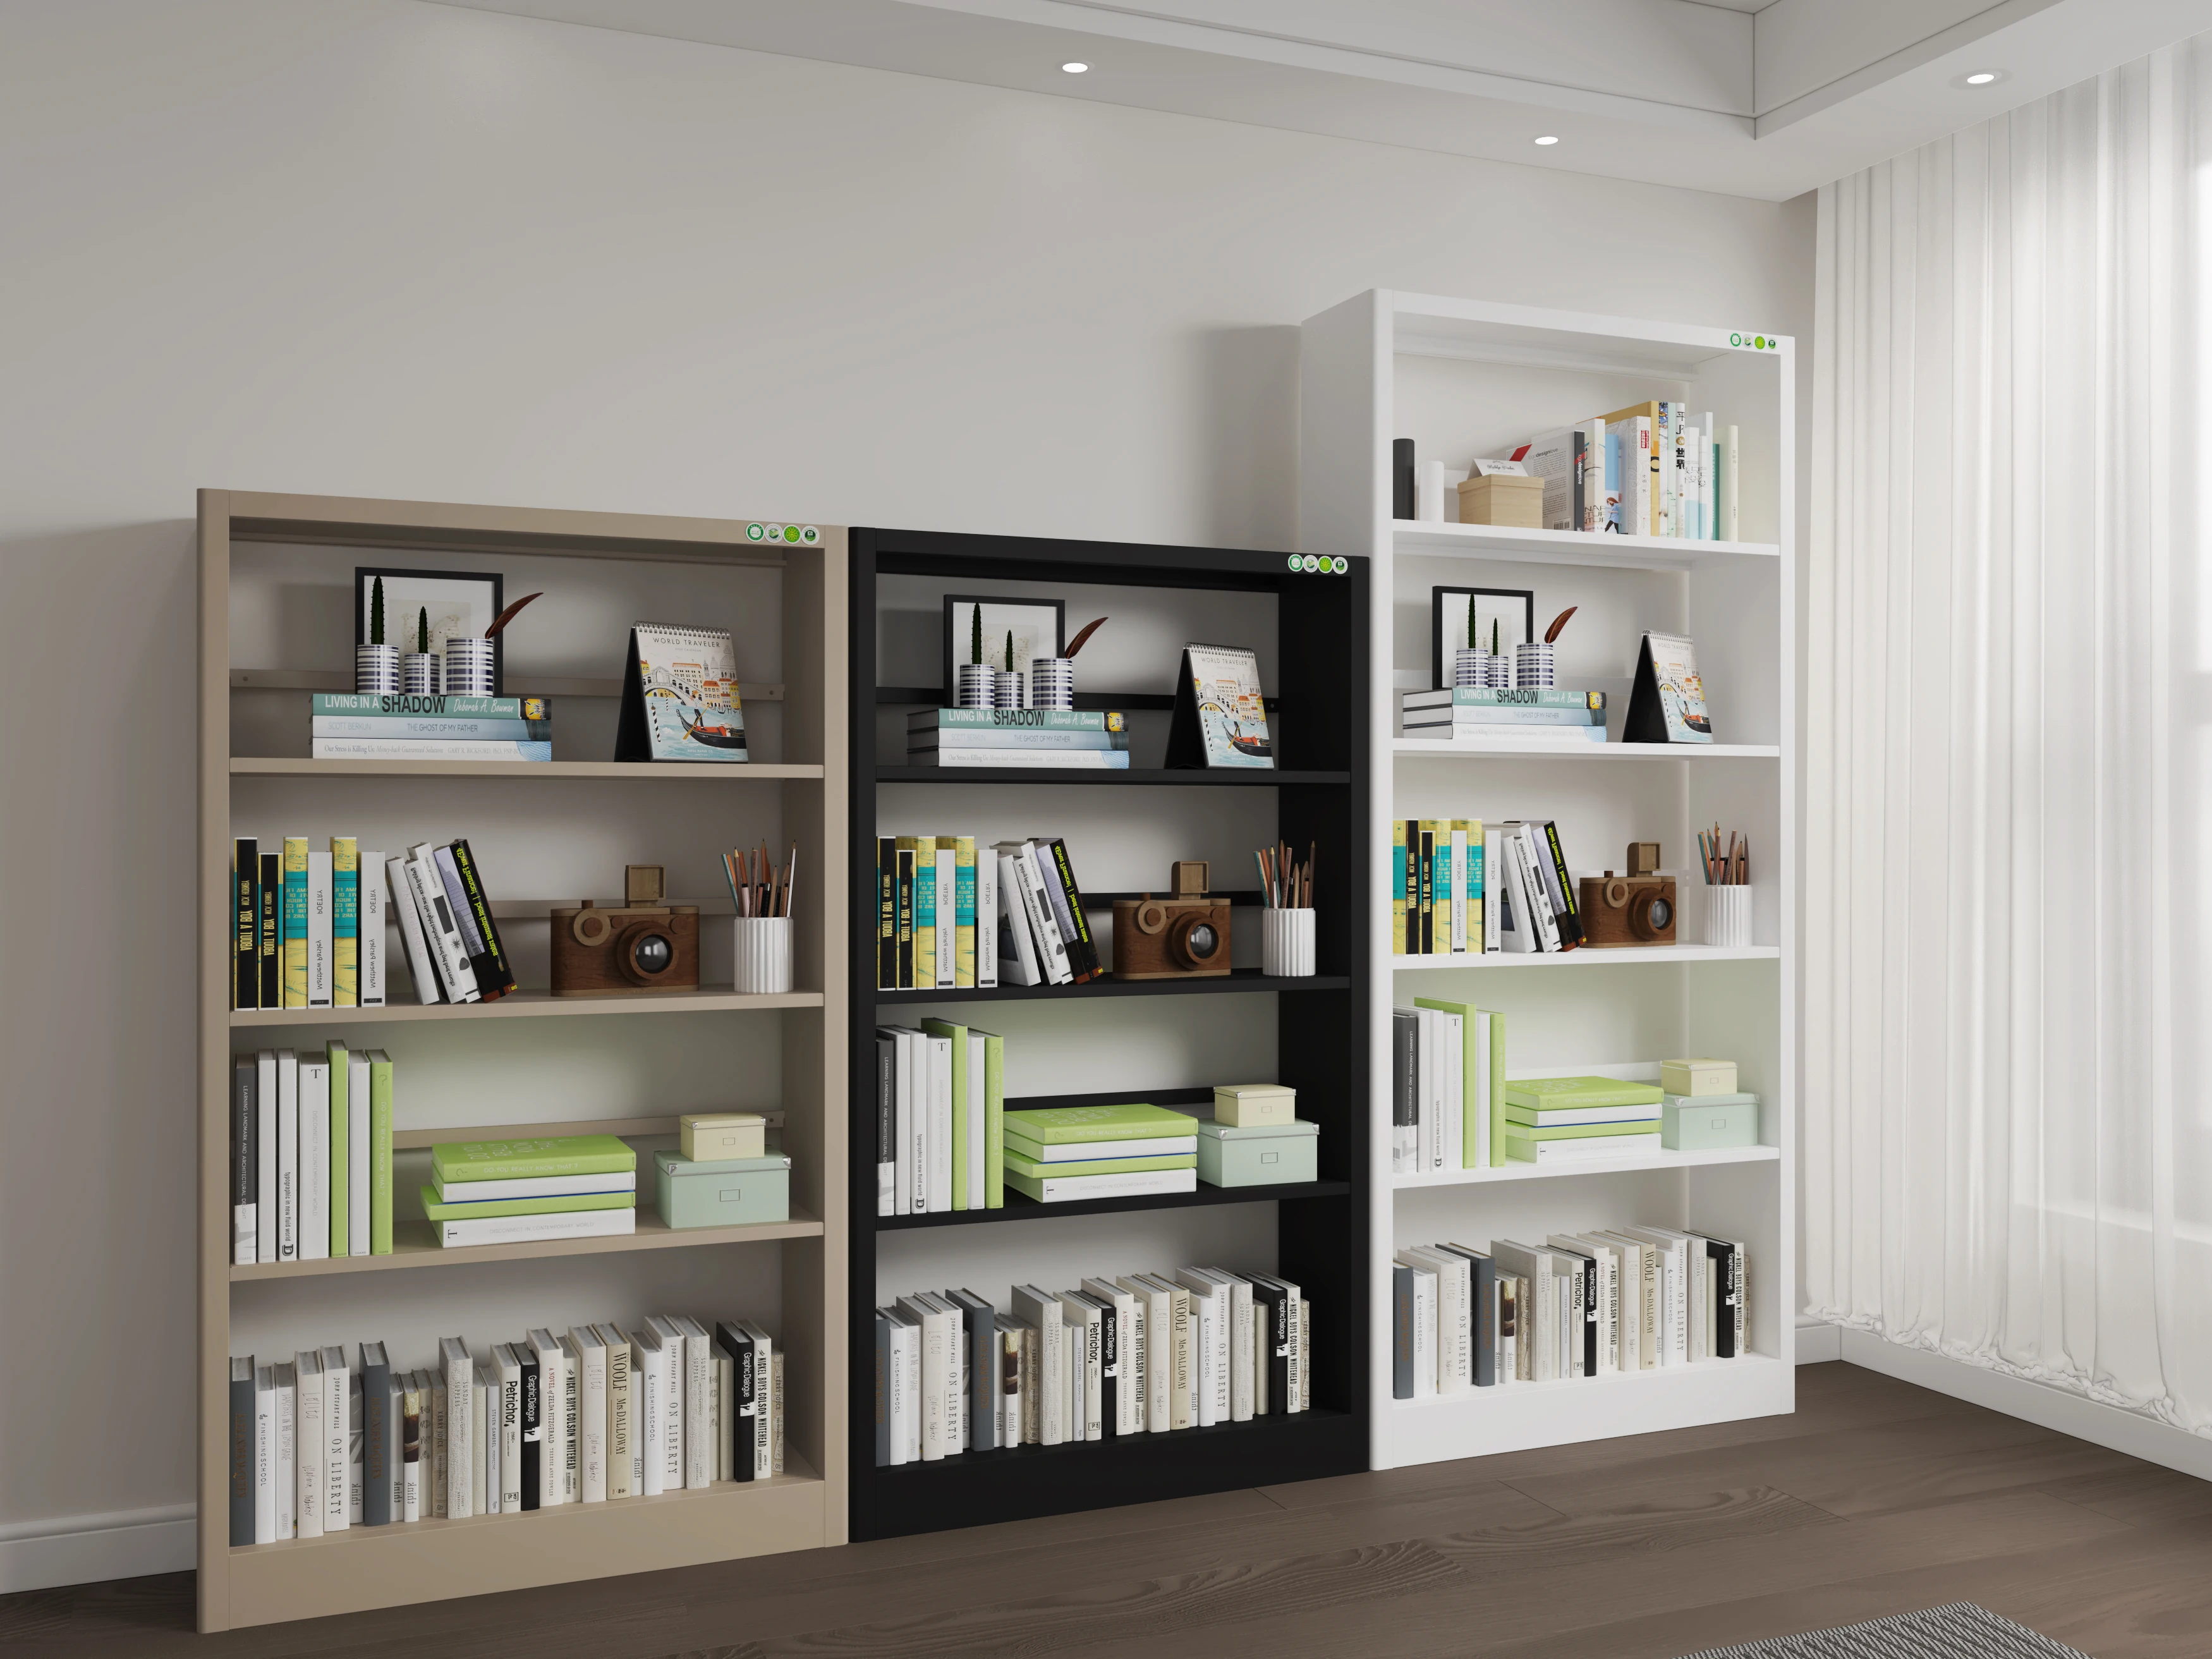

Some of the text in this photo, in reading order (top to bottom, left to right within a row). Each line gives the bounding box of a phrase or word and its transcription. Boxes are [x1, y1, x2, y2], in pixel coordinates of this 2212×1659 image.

[684, 640, 720, 648] TRAVELER
[325, 696, 514, 714] LIVING IN A SHADOW Deborah A. Bowman
[1461, 690, 1583, 704] LIVING IN A SHADOW Deborah A. Bowman
[949, 710, 1099, 726] LIVING IN A SHADOW Deborah A. Bowman
[328, 722, 478, 732] SCOTT BERKUN THE GHOST OF MY FATHER
[352, 745, 367, 754] Killing
[310, 1069, 321, 1079] T
[1644, 1251, 1655, 1283] WOOLF
[1176, 1297, 1187, 1390] WOOLF Mrs DALLOWAY
[566, 1376, 576, 1395] NICKEL
[566, 1397, 576, 1411] BOYS
[612, 1352, 628, 1455] WOOLF Mrs DALLOWAY
[566, 1413, 576, 1437] COLSON
[331, 1438, 342, 1454] ON
[566, 1439, 576, 1469] WHITEHEAD
[331, 1462, 342, 1514] LIBERTY
